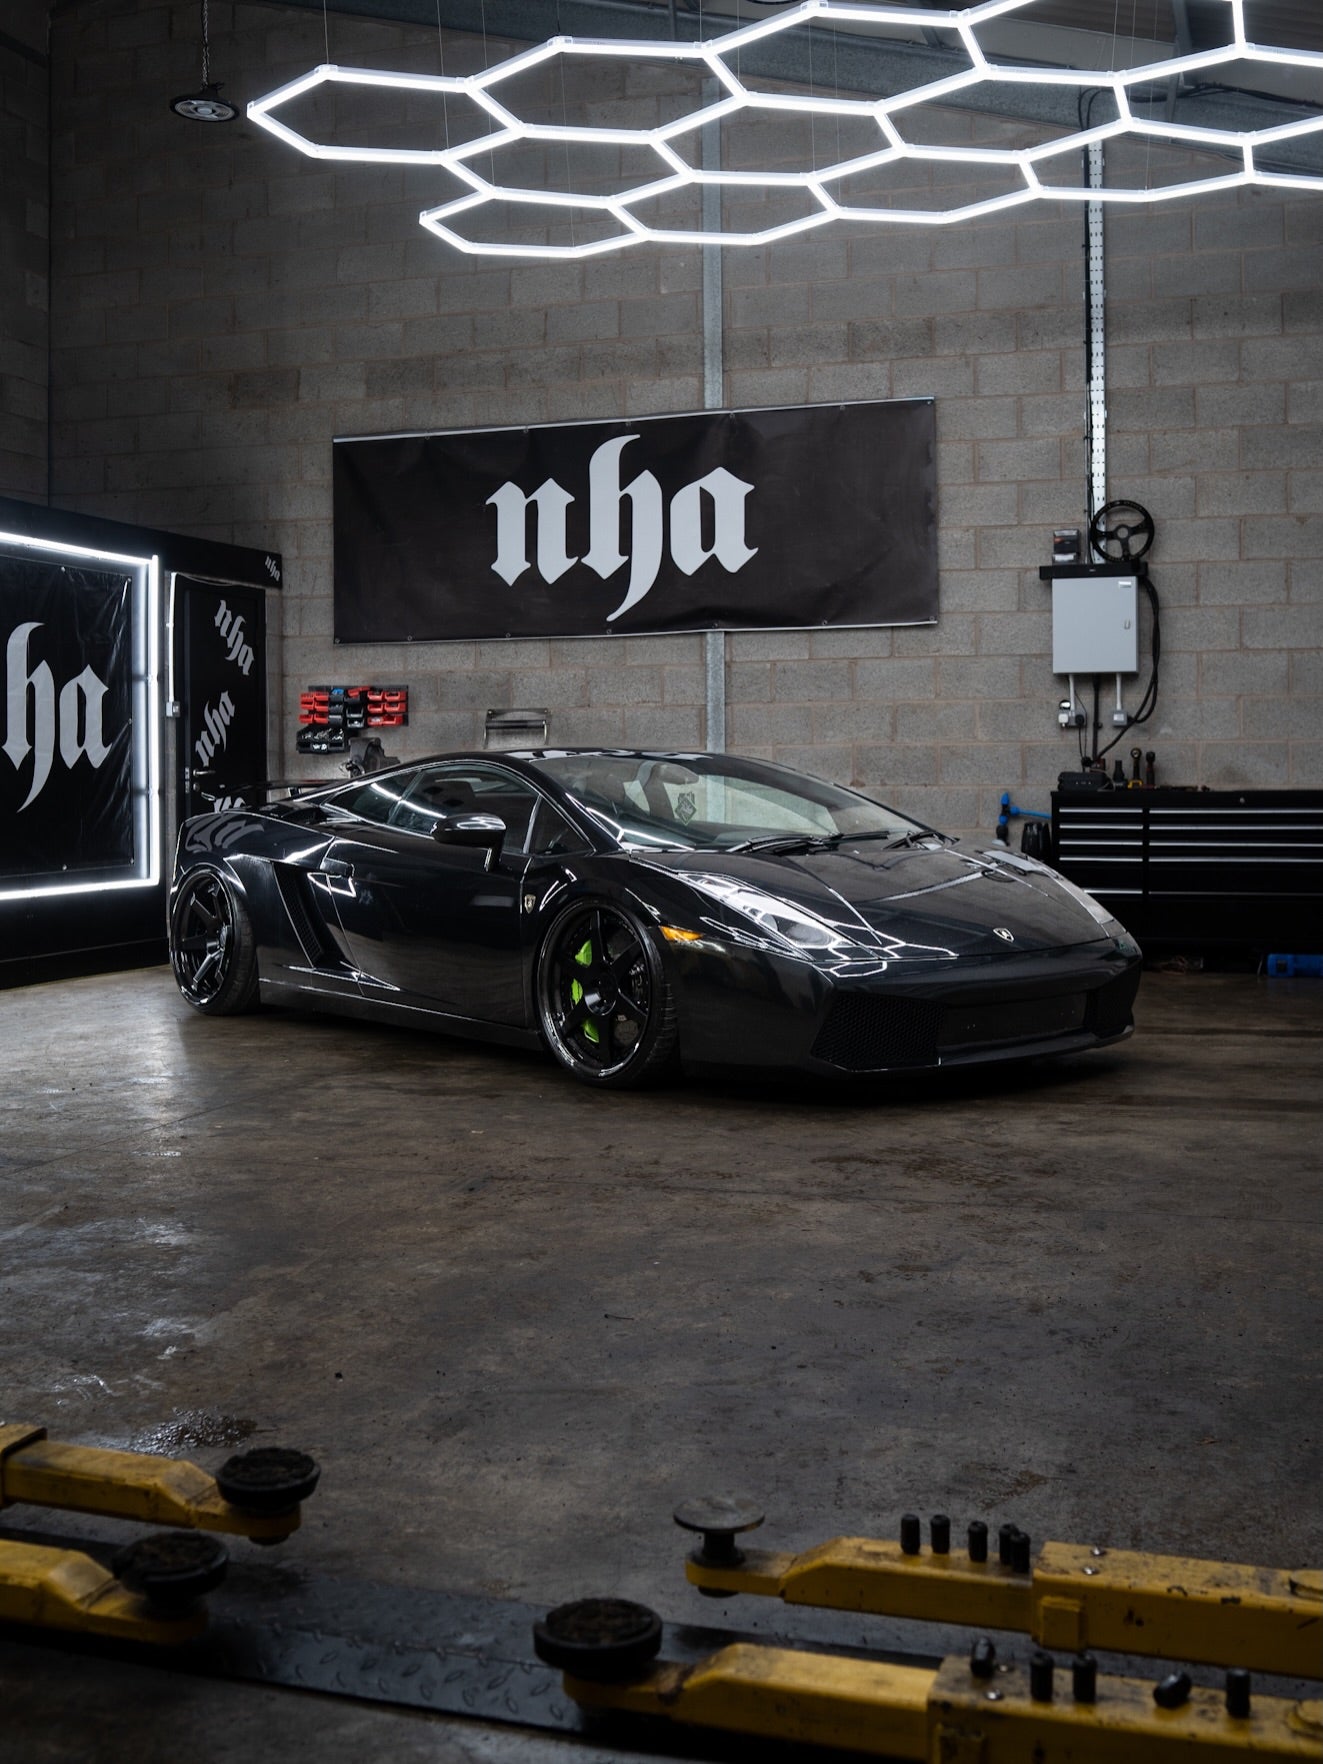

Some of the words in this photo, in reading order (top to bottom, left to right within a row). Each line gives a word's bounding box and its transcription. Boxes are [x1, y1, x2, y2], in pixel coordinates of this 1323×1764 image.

[485, 433, 759, 622] nha
[214, 599, 255, 676] nha
[195, 690, 236, 767] nha
